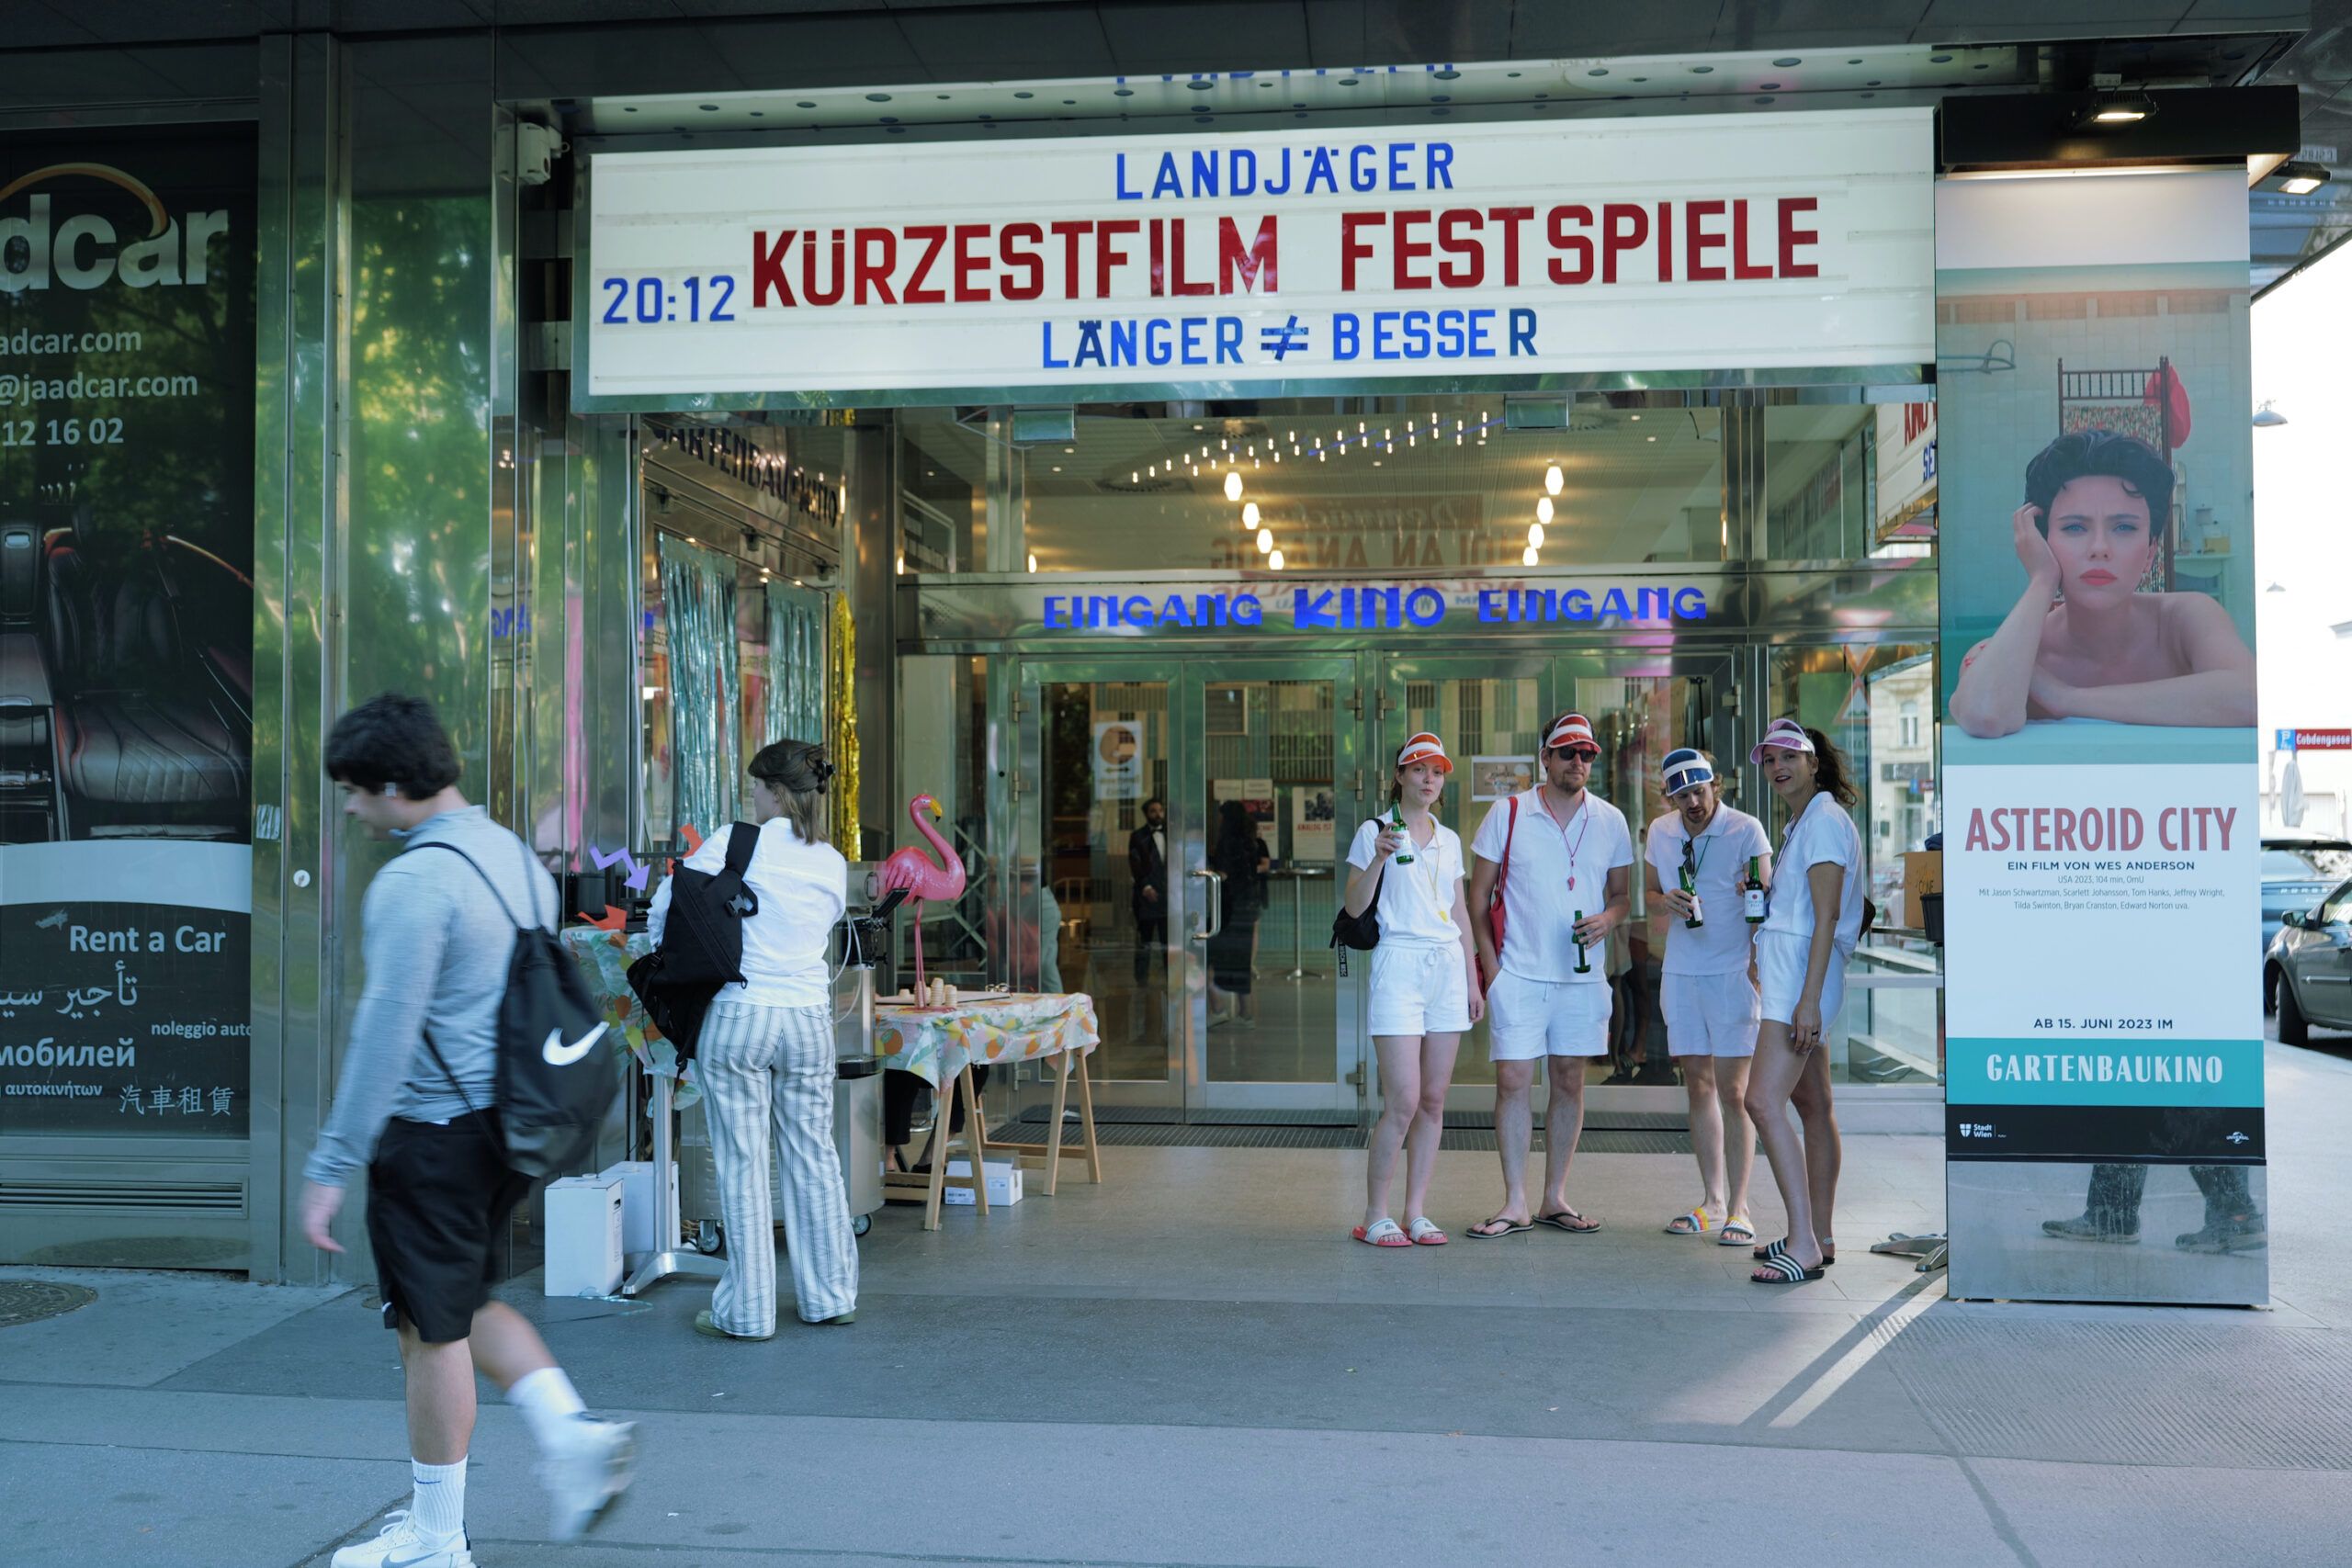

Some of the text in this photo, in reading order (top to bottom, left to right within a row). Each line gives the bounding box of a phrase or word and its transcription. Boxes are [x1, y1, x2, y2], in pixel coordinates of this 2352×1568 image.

[1116, 141, 1454, 201] LANDJÄGER
[752, 197, 1819, 309] KÜRZESTFILM FESTSPIELE
[603, 275, 735, 324] 20:12
[1042, 317, 1243, 369] LÄNGER
[1333, 308, 1539, 361] BESSER
[2, 417, 124, 447] 12 16 02
[1044, 593, 1263, 629] EINGANG
[1293, 586, 1446, 629] KINO
[1477, 586, 1707, 624] EINGANG
[1964, 807, 2237, 852] ASTEROID CITY
[2007, 861, 2195, 871] EIN FILM VON WES ANDERSON
[2057, 875, 2074, 884] USA
[2096, 875, 2109, 884] 104
[1978, 888, 1990, 897] Mit
[1991, 888, 2012, 897] Jason
[2063, 888, 2090, 897] Scarlett
[2132, 888, 2147, 897] Tom
[2148, 888, 2172, 897] Hanks,
[2173, 888, 2198, 898] Jeffrey
[2014, 901, 2031, 909] Tilda
[2064, 901, 2085, 911] Bryan
[2120, 901, 2147, 909] Edward
[2148, 901, 2174, 909] Norton
[70, 925, 226, 953] Rent a Car
[56, 959, 138, 1019] تأجير
[151, 1019, 217, 1039] noleggio
[2033, 1018, 2173, 1030] AB 15. JUNI 2023 IM
[1986, 1054, 2223, 1084] GARTENBAUKINO
[119, 1084, 234, 1116] 汽車租賃
[1973, 1123, 1993, 1132] Stadt
